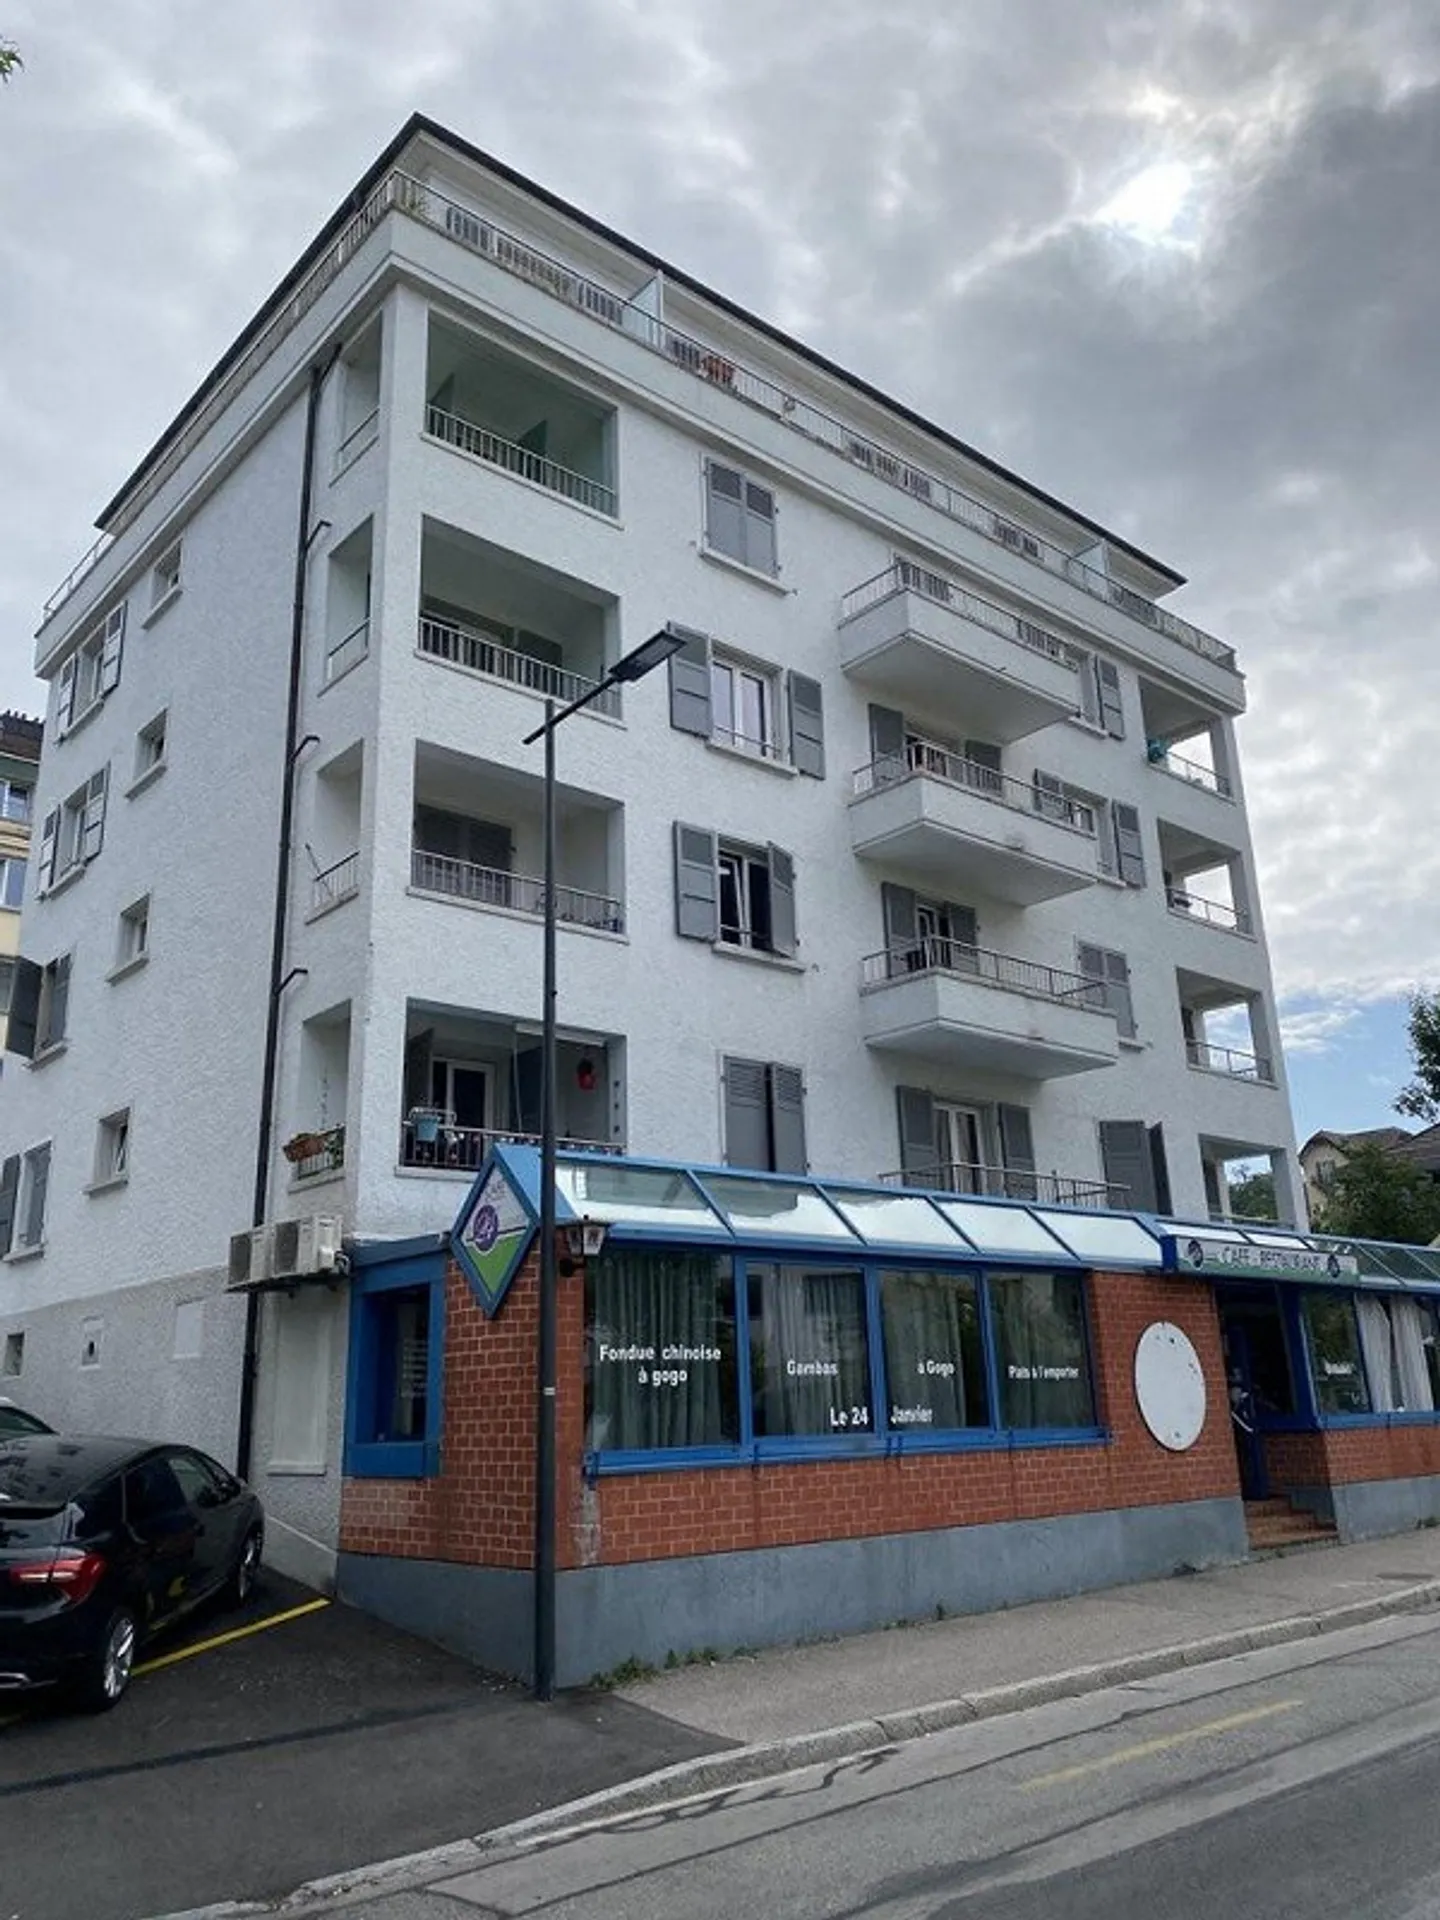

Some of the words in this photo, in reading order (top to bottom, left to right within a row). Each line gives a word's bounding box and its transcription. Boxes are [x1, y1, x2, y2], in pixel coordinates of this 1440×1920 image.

[600, 1344, 655, 1361] Fondue
[662, 1343, 721, 1360] chinoise
[638, 1365, 648, 1384] à
[652, 1369, 688, 1387] gogo
[787, 1359, 838, 1376] Gambas
[926, 1359, 955, 1378] Gogo
[830, 1406, 848, 1426] Le
[851, 1406, 869, 1425] 24
[890, 1403, 933, 1424] Janvier
